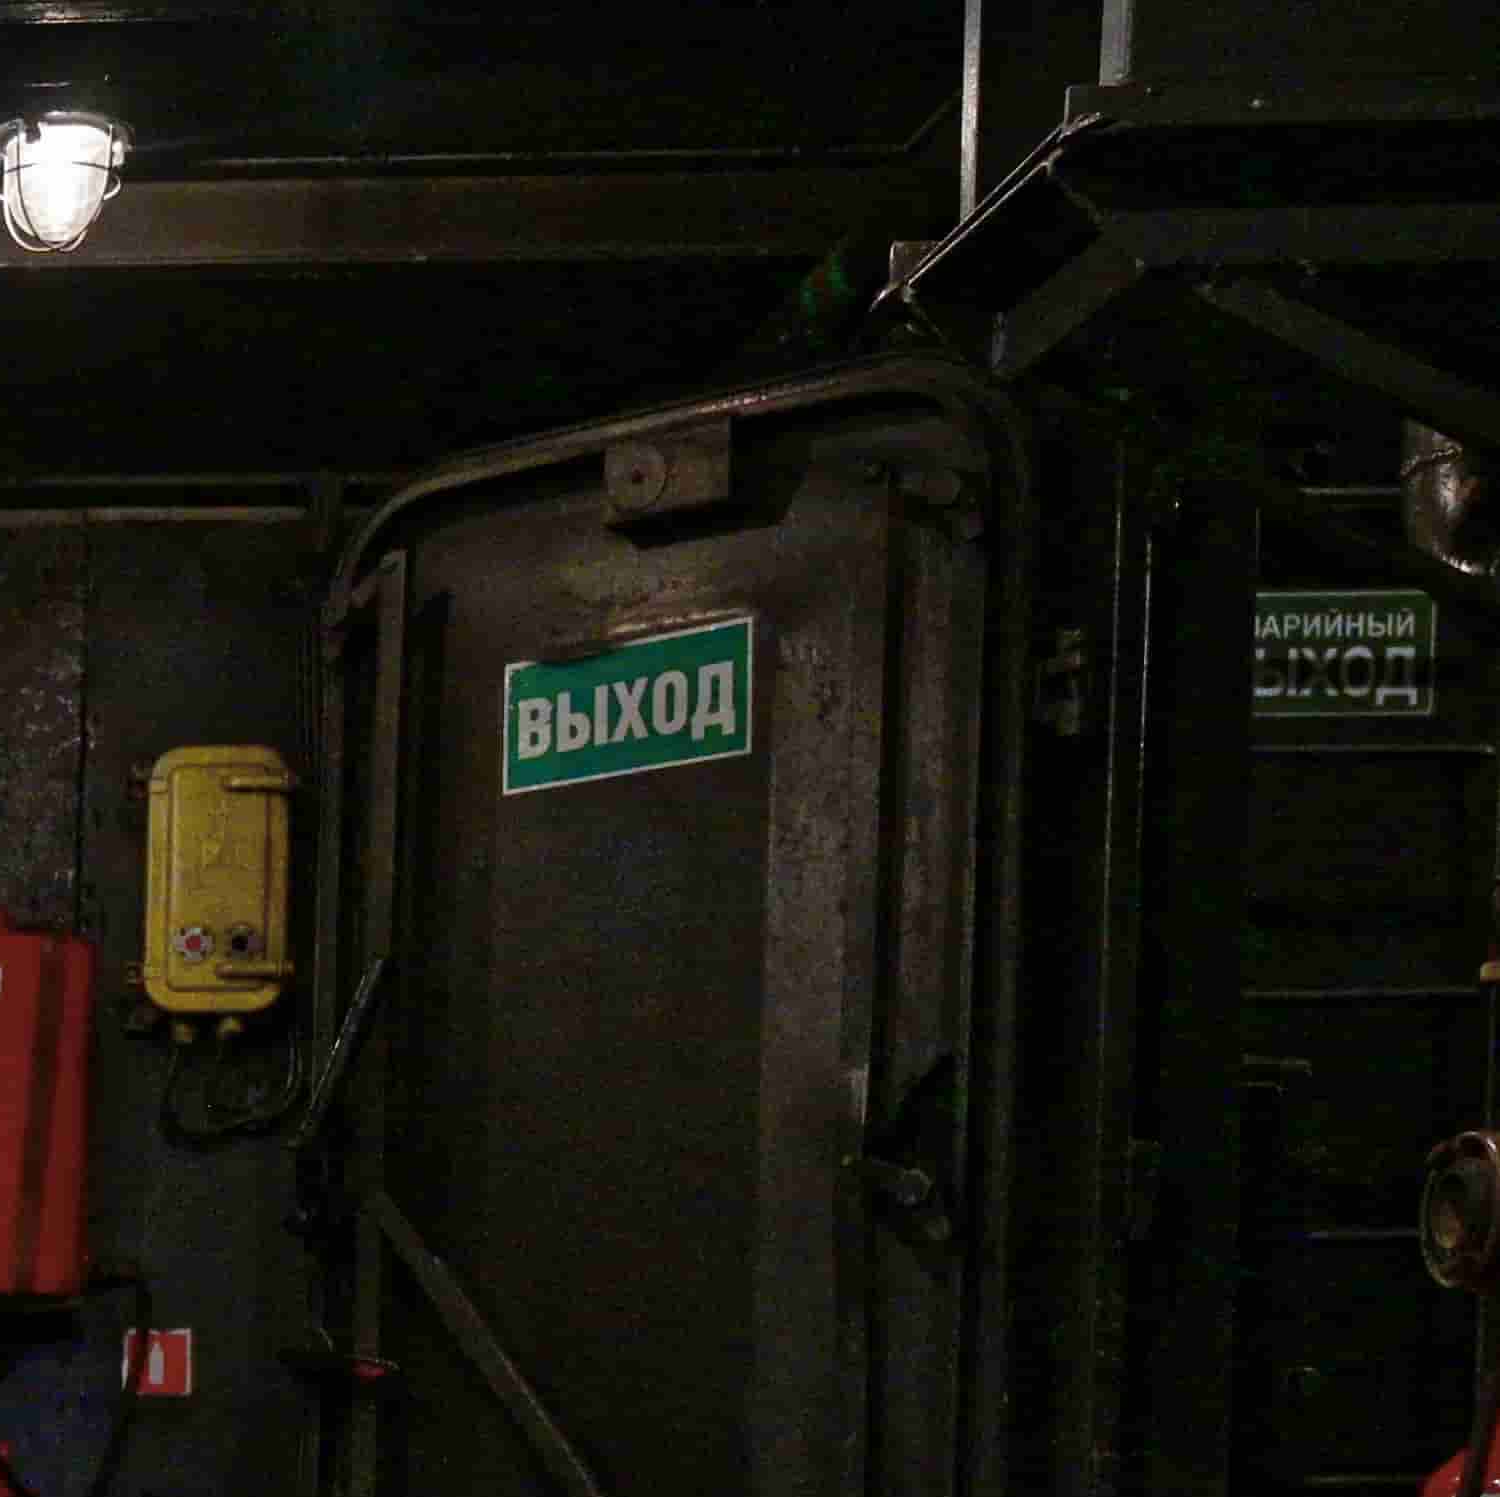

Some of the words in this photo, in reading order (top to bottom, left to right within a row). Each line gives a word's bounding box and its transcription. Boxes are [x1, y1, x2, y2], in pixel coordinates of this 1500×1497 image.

[1252, 608, 1416, 640] АРИЙНЫЙ
[1253, 644, 1419, 706] ЫХОД
[517, 660, 737, 761] ВЫХОД
